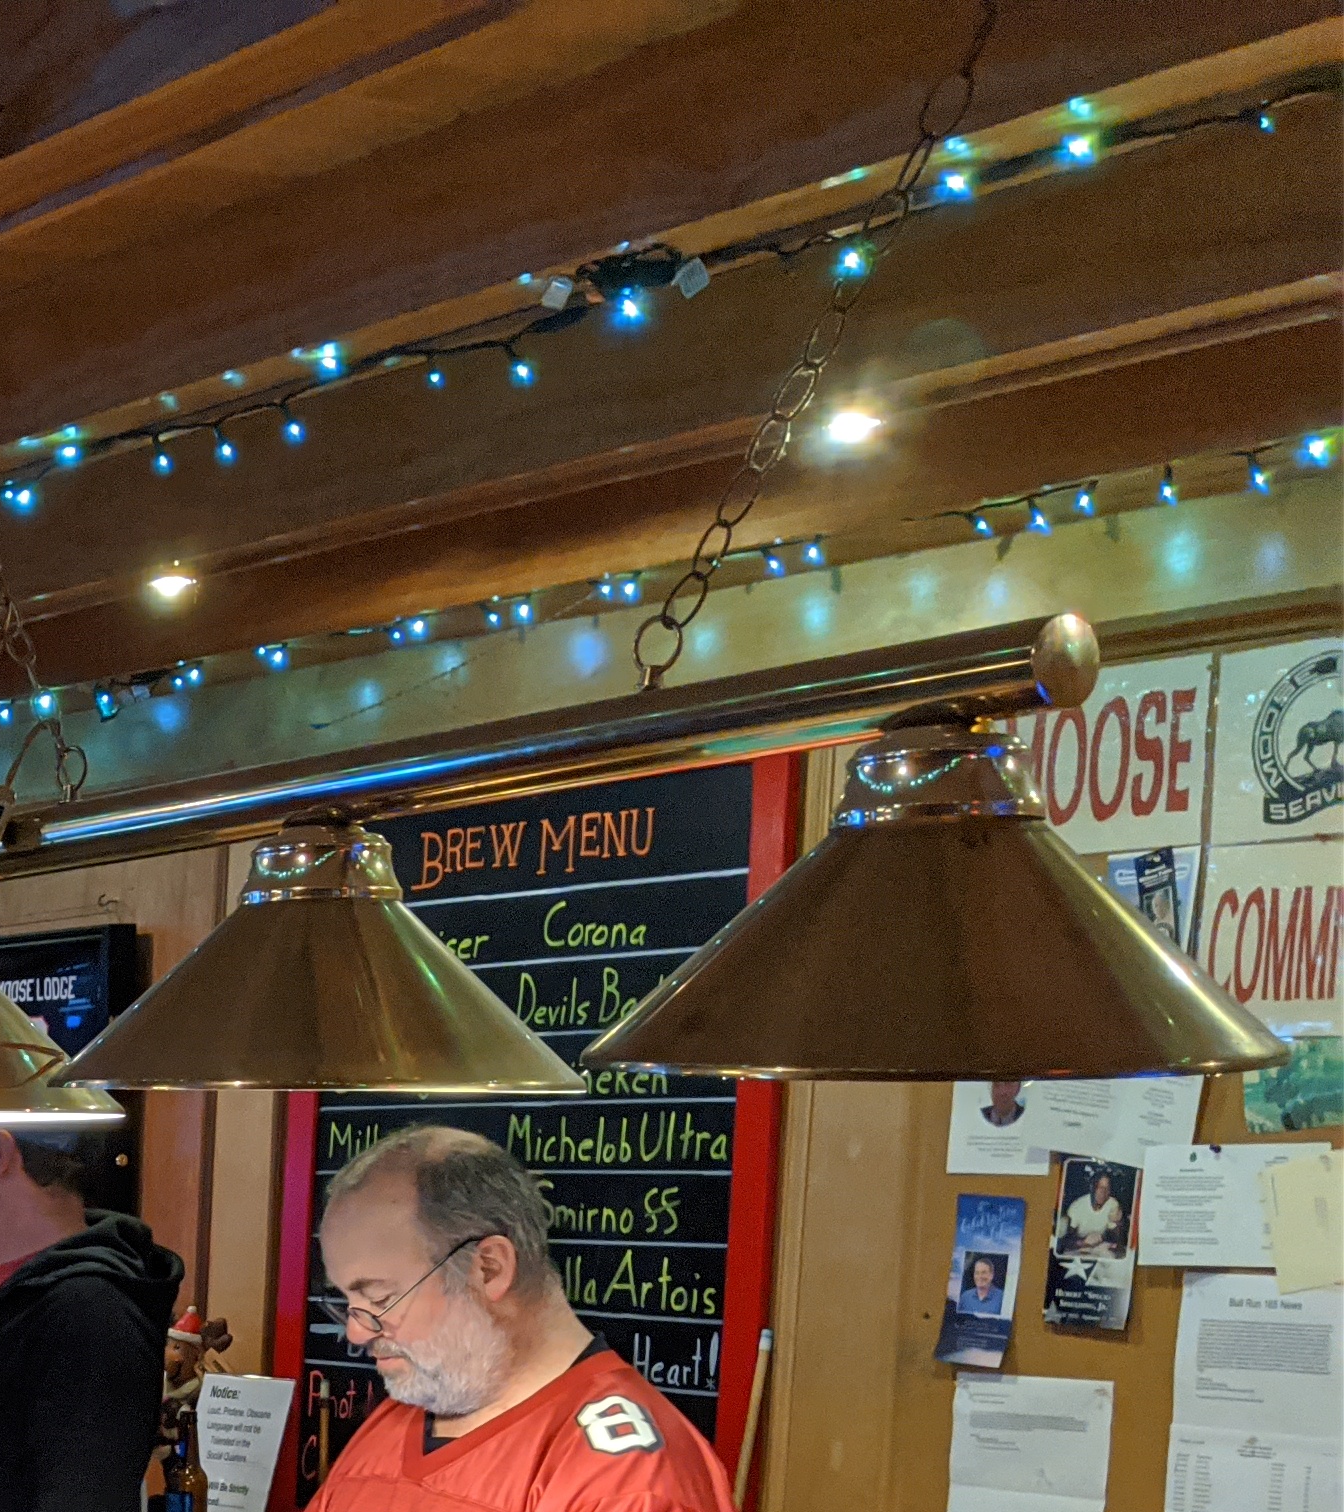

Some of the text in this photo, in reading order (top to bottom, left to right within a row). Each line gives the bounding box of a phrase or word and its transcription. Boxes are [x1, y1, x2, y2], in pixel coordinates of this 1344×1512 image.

[411, 807, 656, 891] BREW MENU
[543, 900, 647, 948] Corona
[36, 975, 78, 1002] LODGE
[518, 972, 590, 1026] Devils
[507, 1113, 632, 1164] Michelob
[638, 1111, 728, 1164] Ultra
[603, 1249, 718, 1315] Artois
[209, 1385, 242, 1400] Notice:
[307, 1370, 357, 1419] Pnot
[575, 1394, 665, 1455] 8
